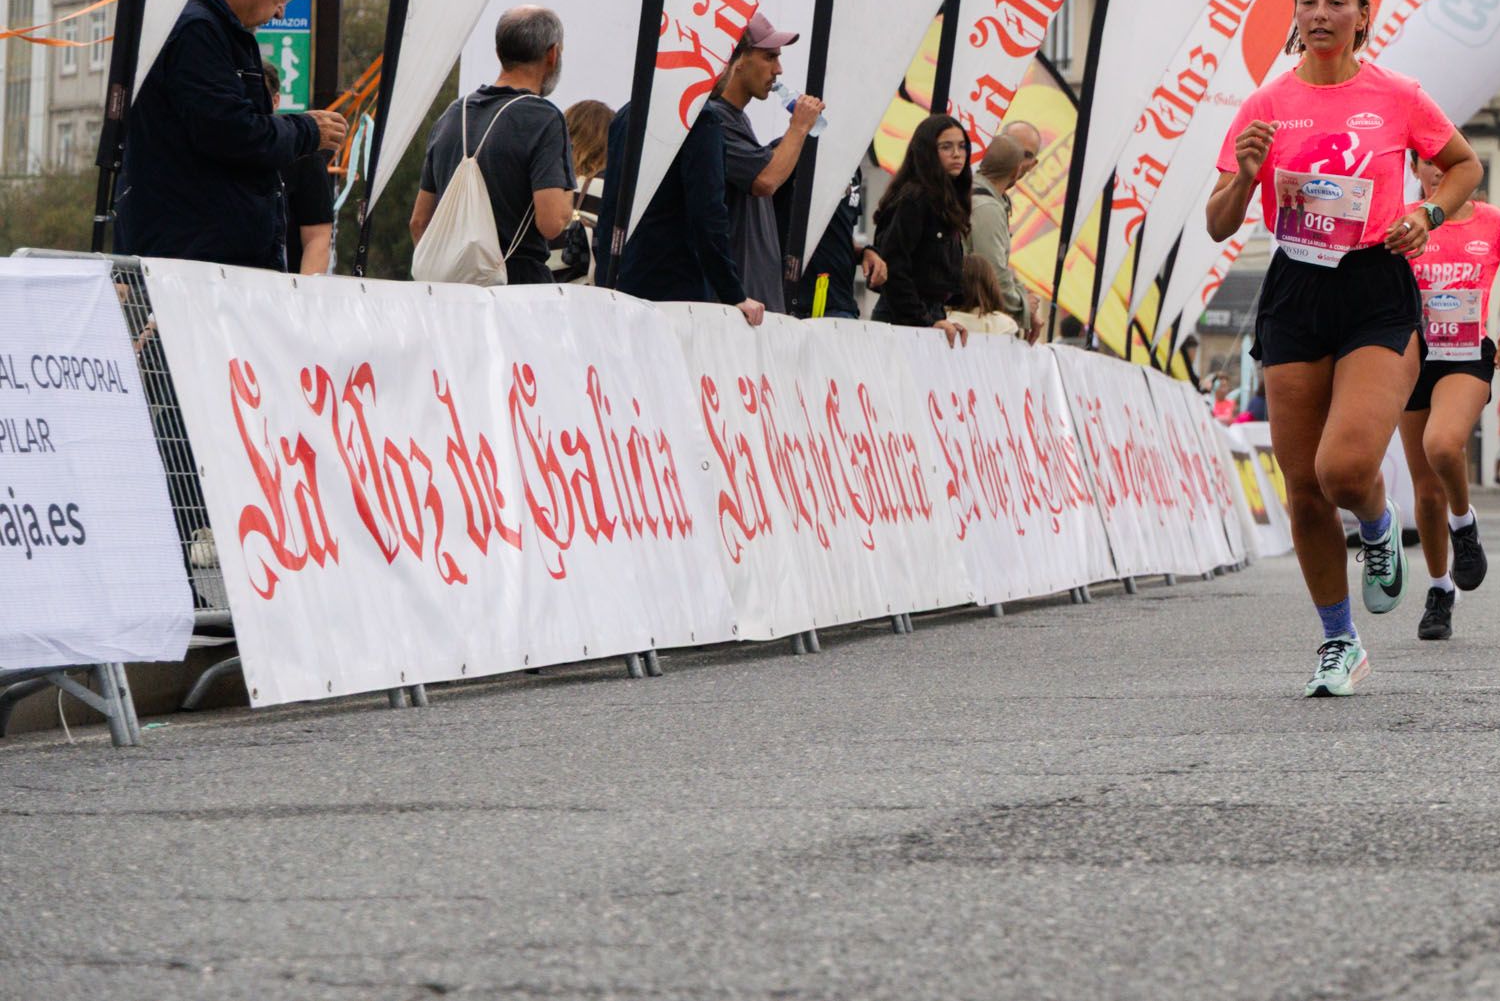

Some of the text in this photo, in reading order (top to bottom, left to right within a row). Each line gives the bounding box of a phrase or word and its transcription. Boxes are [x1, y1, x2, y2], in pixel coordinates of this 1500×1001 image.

[272, 18, 308, 27] RIAZOR
[1135, 44, 1217, 141] Voz
[1304, 213, 1335, 232] 016
[1430, 322, 1459, 334] 016
[31, 354, 128, 394] CORPORAL
[229, 358, 692, 600] La Voz de Galicia
[701, 373, 773, 564] La
[0, 486, 86, 560] aja.es
